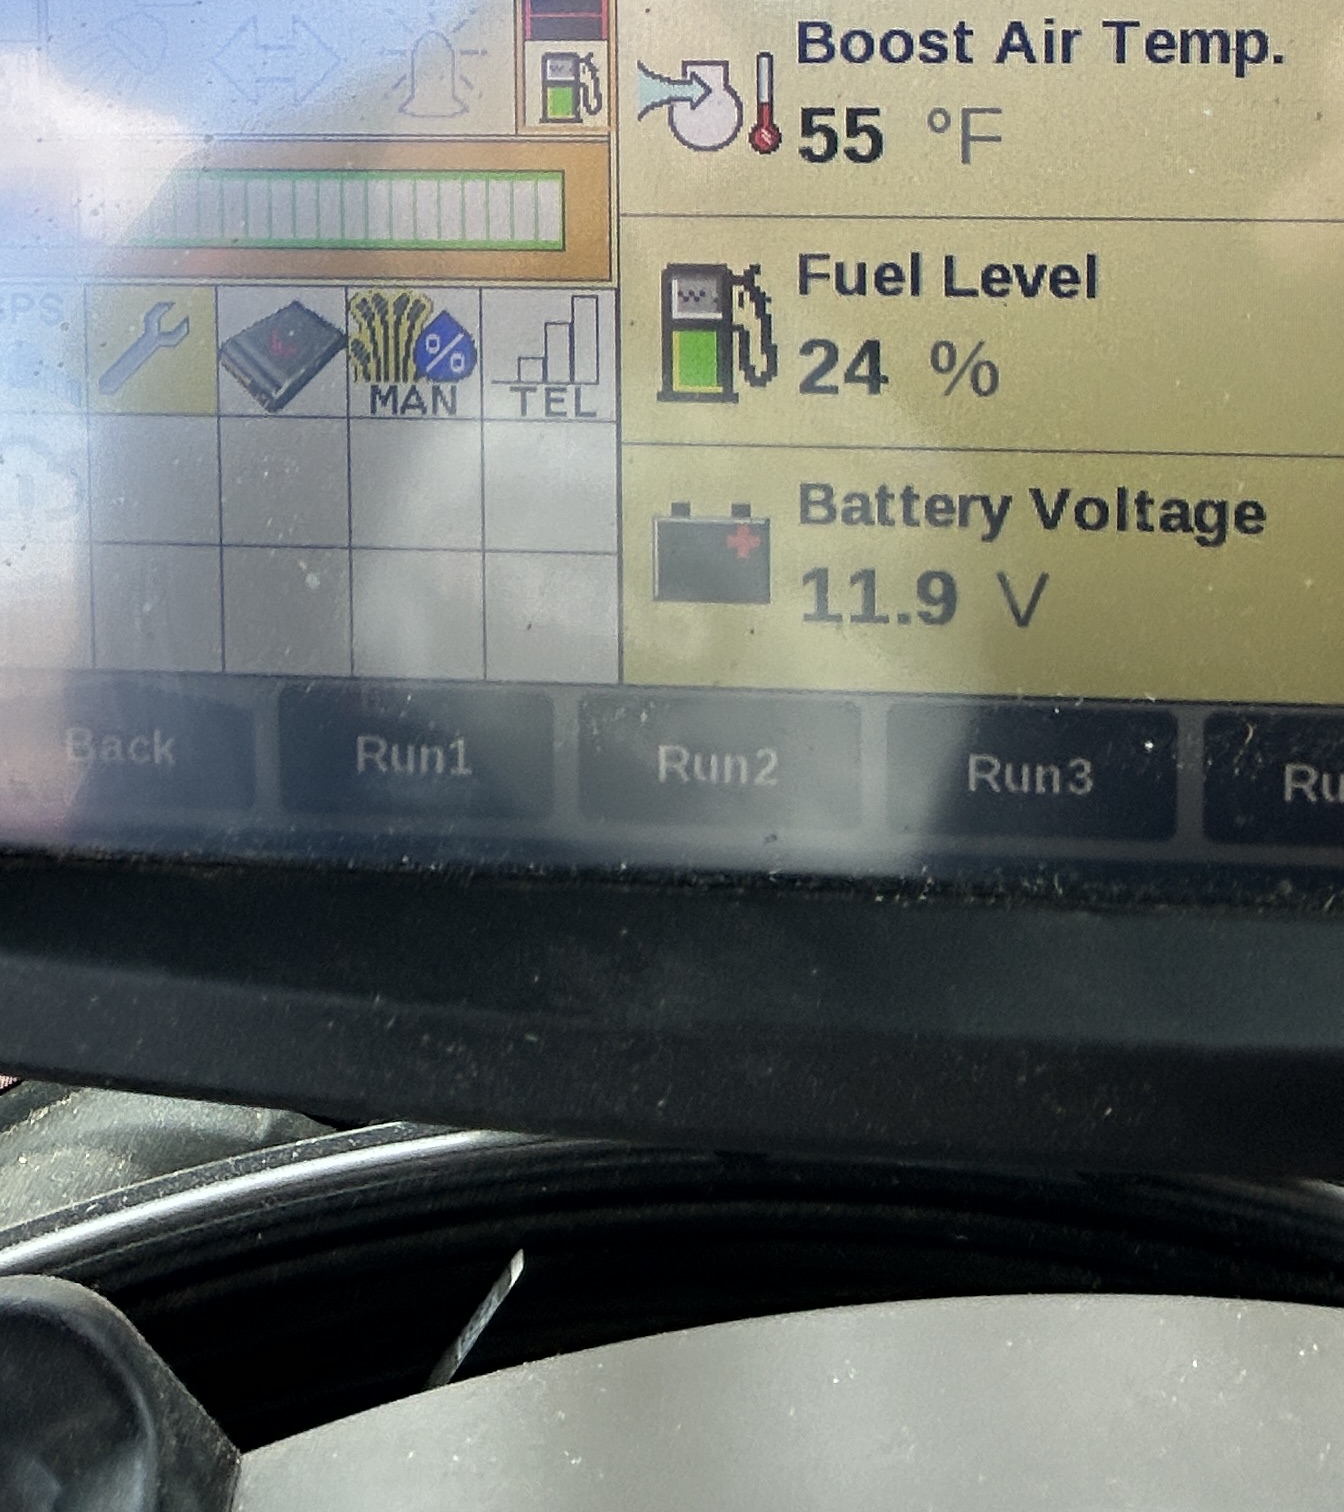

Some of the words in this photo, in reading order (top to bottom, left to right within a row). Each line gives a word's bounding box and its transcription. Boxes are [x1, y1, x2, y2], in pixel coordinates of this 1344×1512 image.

[797, 20, 973, 65] Boost
[996, 20, 1082, 65] Air
[1103, 20, 1284, 78] Temp.
[799, 107, 883, 163] 55
[927, 107, 1002, 164] °F
[798, 252, 921, 298] Fuel
[944, 253, 1097, 299] Level
[425, 333, 465, 373] %
[799, 339, 888, 395] 24
[931, 340, 999, 398] %
[371, 385, 457, 415] MAN
[517, 386, 597, 418] TEL
[798, 482, 1012, 543] Battery
[1030, 487, 1267, 548] Voltage
[803, 567, 958, 625] 11.9
[997, 571, 1049, 628] V
[65, 728, 175, 767] Back
[356, 736, 473, 777] Run1
[656, 744, 779, 786] Run2
[968, 754, 1094, 798] Run3
